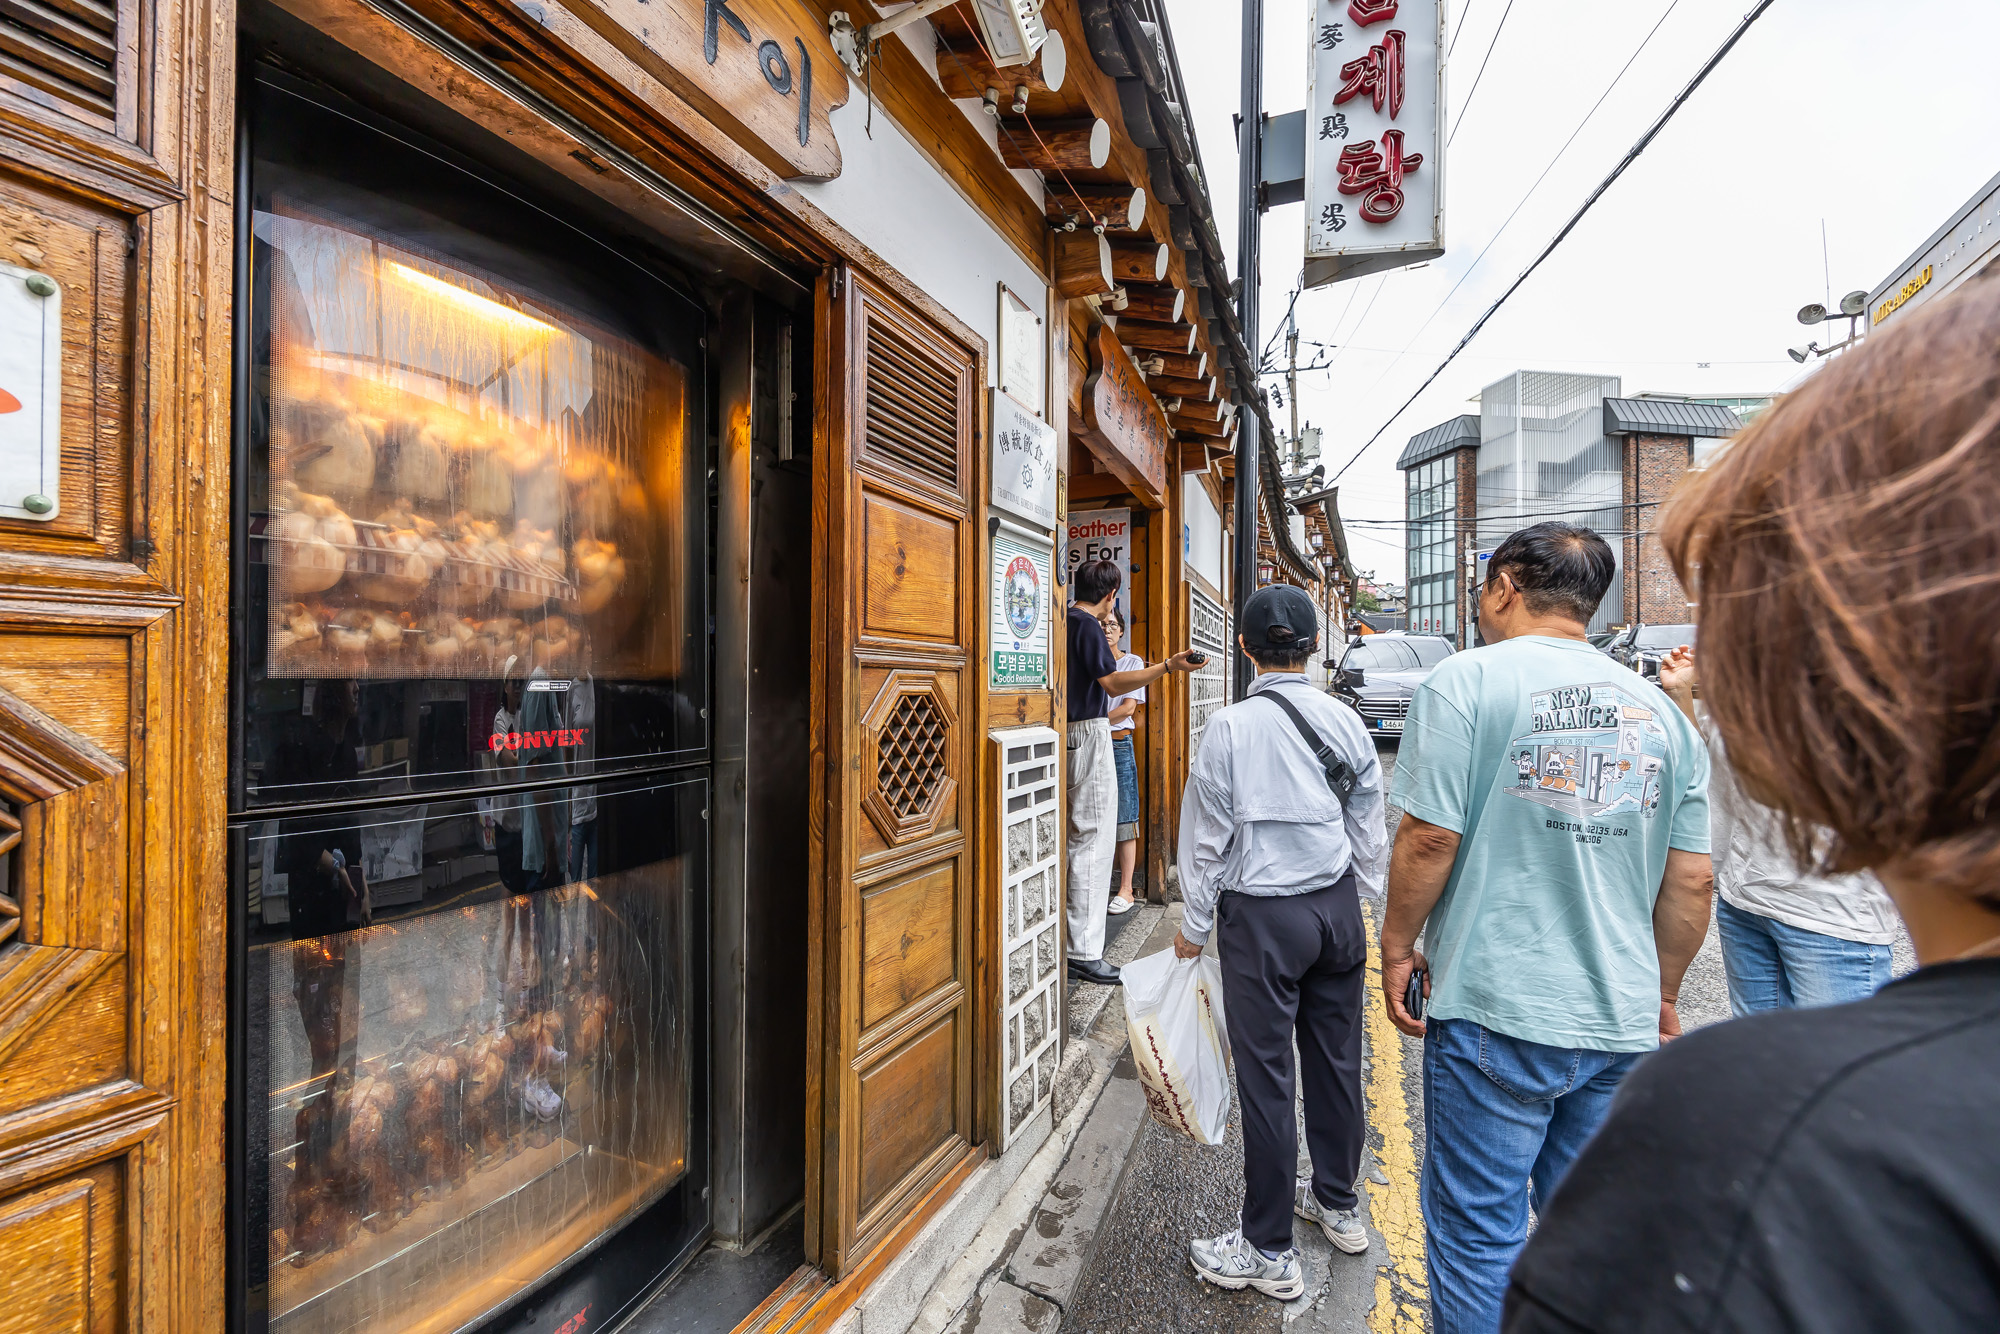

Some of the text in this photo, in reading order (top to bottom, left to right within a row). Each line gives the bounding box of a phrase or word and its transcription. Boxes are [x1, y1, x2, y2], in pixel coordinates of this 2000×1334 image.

[1873, 264, 1934, 326] MIRABEAU
[1067, 519, 1127, 540] eather
[1086, 543, 1123, 561] For
[997, 654, 1044, 672] 모범음식점
[997, 673, 1043, 684] Good Restaurant
[1548, 686, 1592, 711] NEW
[1531, 705, 1619, 732] BALANCE
[488, 728, 585, 751] CONVEX
[1554, 738, 1573, 746] BOSTON
[1613, 828, 1628, 837] USA
